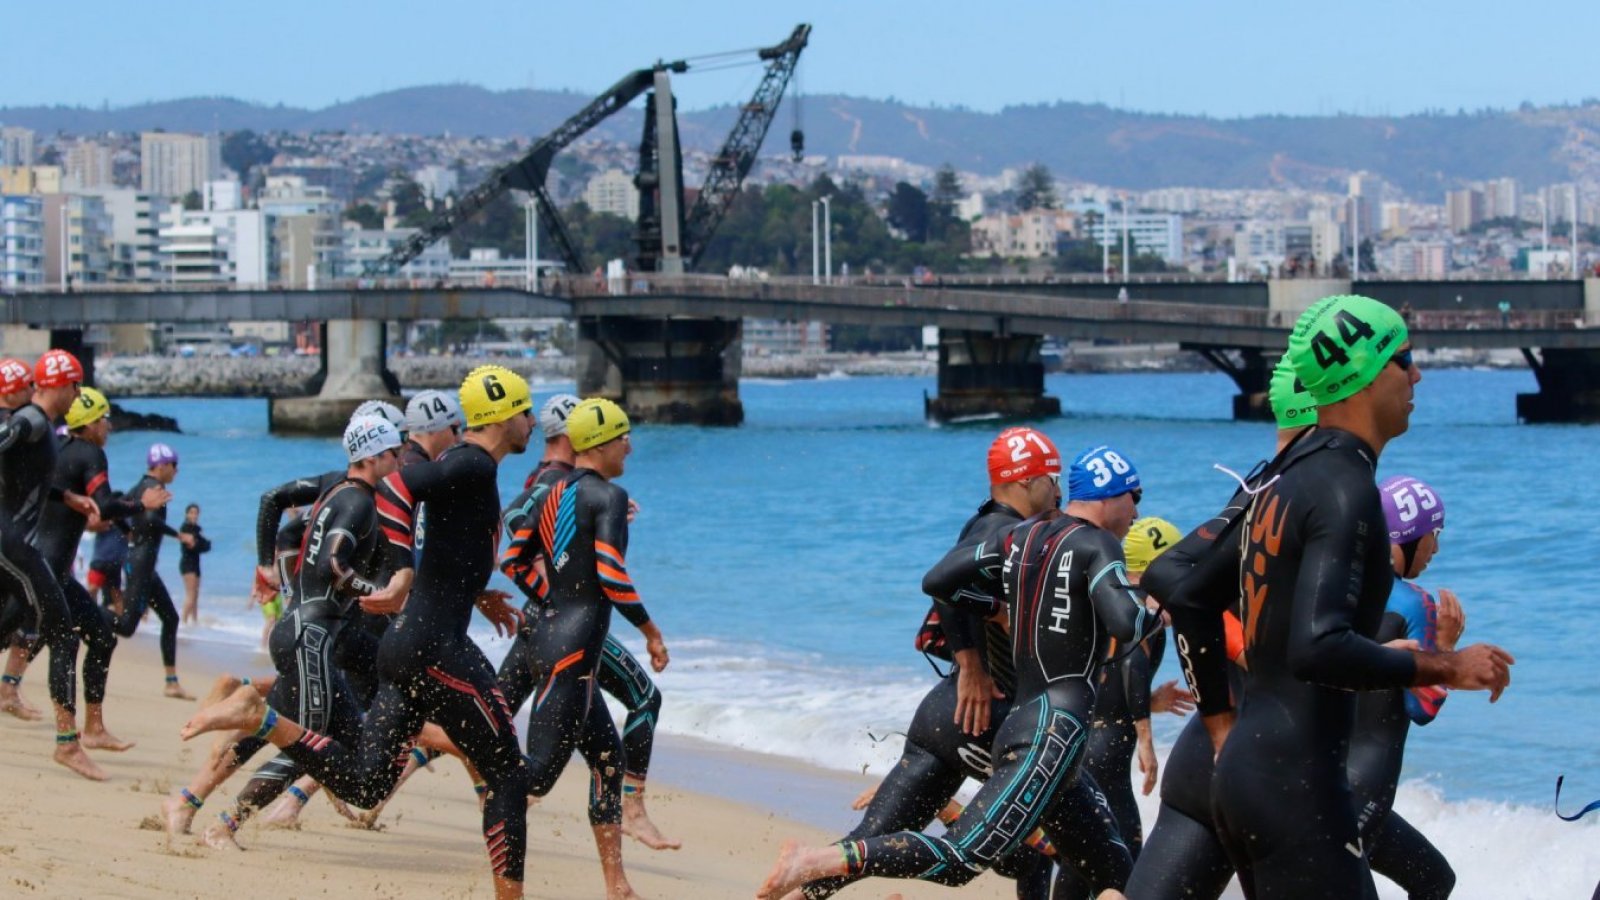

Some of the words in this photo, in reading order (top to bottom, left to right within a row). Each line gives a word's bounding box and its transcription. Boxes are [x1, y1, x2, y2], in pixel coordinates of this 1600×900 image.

[1311, 309, 1376, 370] 44
[1, 361, 27, 384] 25
[46, 354, 73, 377] 22
[81, 394, 95, 409] 8
[483, 375, 506, 402] 6
[419, 397, 448, 420] 14
[590, 405, 606, 426] 7
[348, 424, 389, 456] RACE
[1007, 432, 1050, 463] 21
[1086, 450, 1130, 488] 38
[1391, 482, 1438, 522] 55
[1147, 526, 1168, 551] 2
[1048, 550, 1074, 634] HUUB
